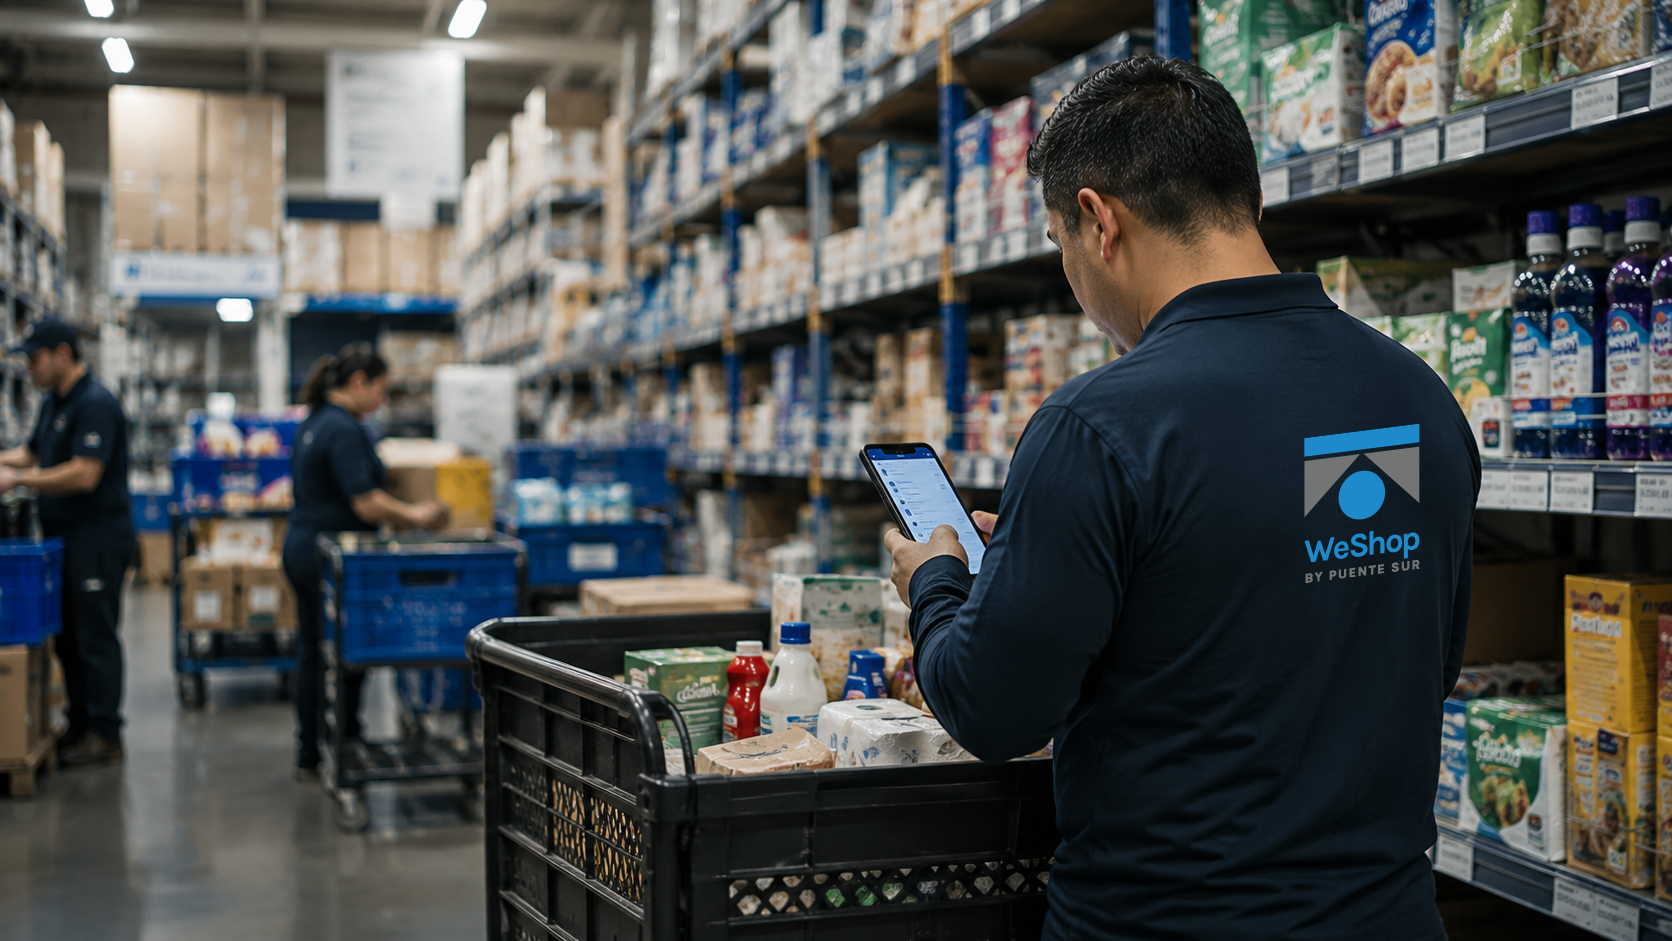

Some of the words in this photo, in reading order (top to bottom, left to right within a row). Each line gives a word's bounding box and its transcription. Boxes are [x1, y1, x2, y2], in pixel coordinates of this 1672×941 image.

[1304, 530, 1420, 562] WeShop
[1305, 571, 1323, 583] BY
[1329, 563, 1385, 580] PUENTE
[1391, 560, 1421, 573] SUR
